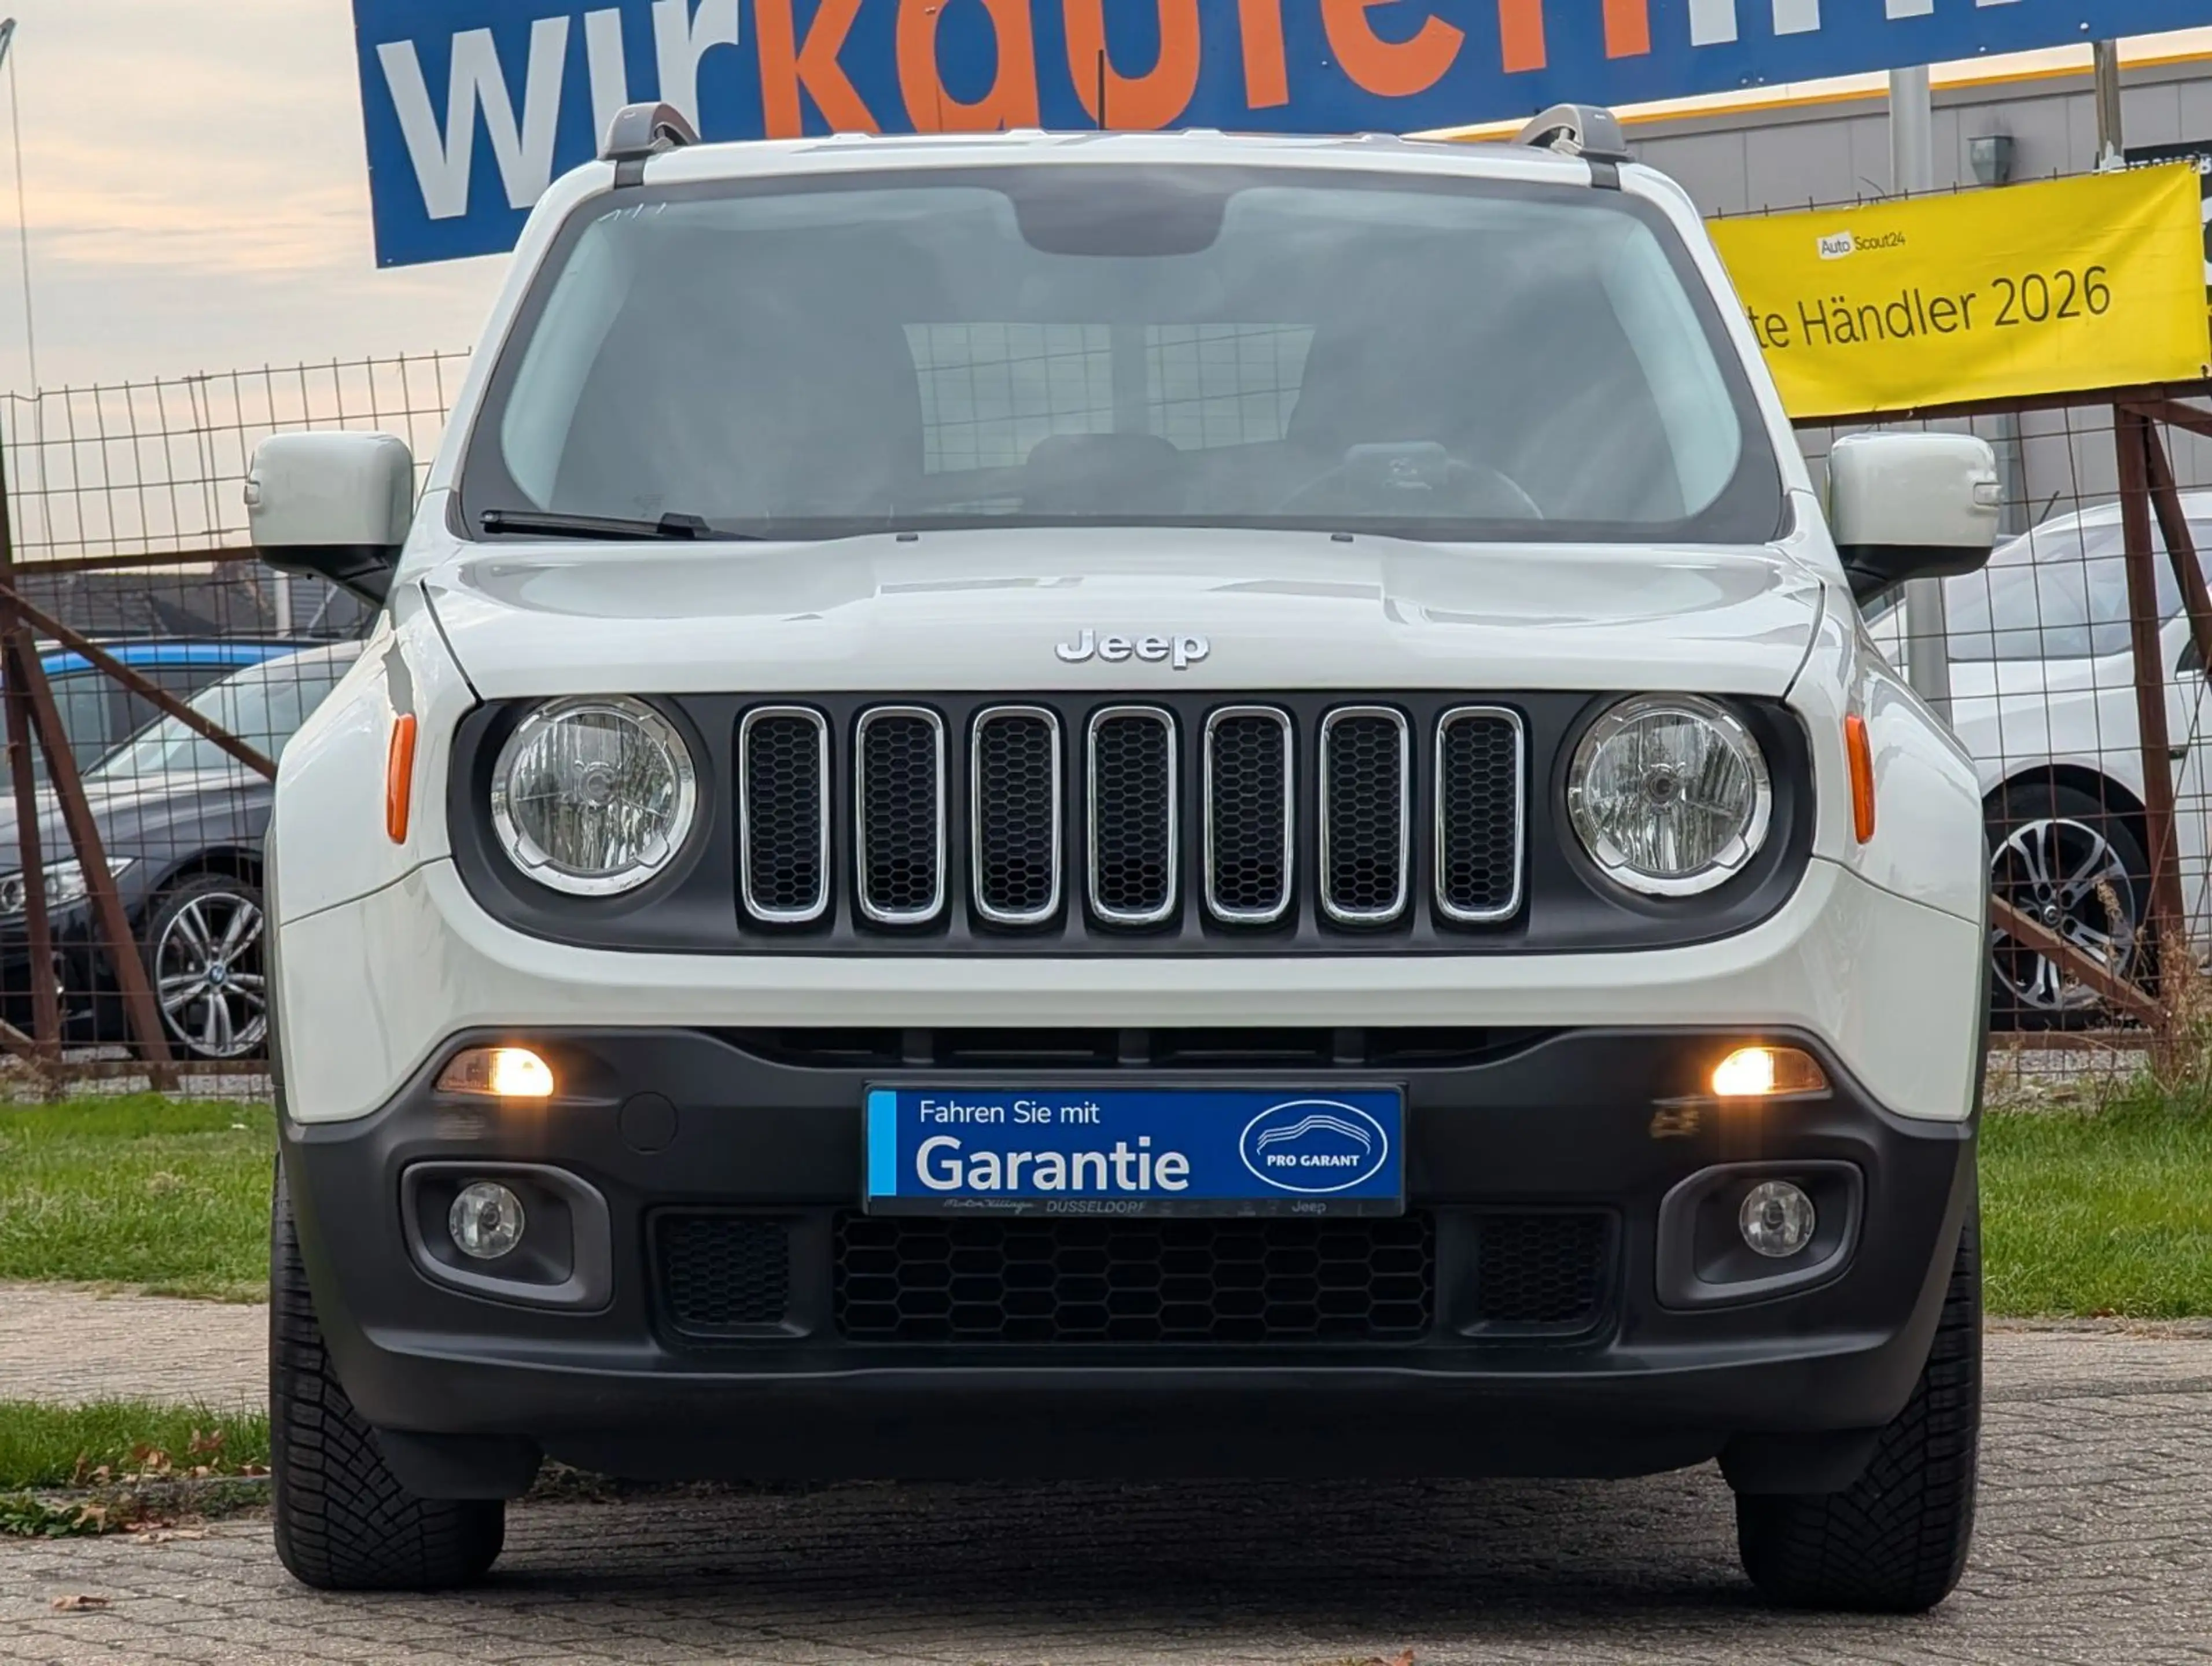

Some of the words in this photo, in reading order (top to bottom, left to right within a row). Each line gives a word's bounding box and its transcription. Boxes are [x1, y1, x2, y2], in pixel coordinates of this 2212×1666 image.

[1822, 240, 1850, 253] Auto
[1854, 232, 1906, 250] Scout24
[1798, 288, 1977, 345] Händler
[1991, 266, 2110, 326] 2026
[1055, 628, 1210, 671] Jeep
[921, 1100, 1004, 1123] Fahren
[1014, 1100, 1051, 1123] Sie
[1061, 1101, 1100, 1123] mit
[916, 1135, 1190, 1191] Garantie
[1267, 1155, 1297, 1166] PRO
[1300, 1155, 1360, 1166] GARANT
[1291, 1200, 1326, 1214] Jeep
